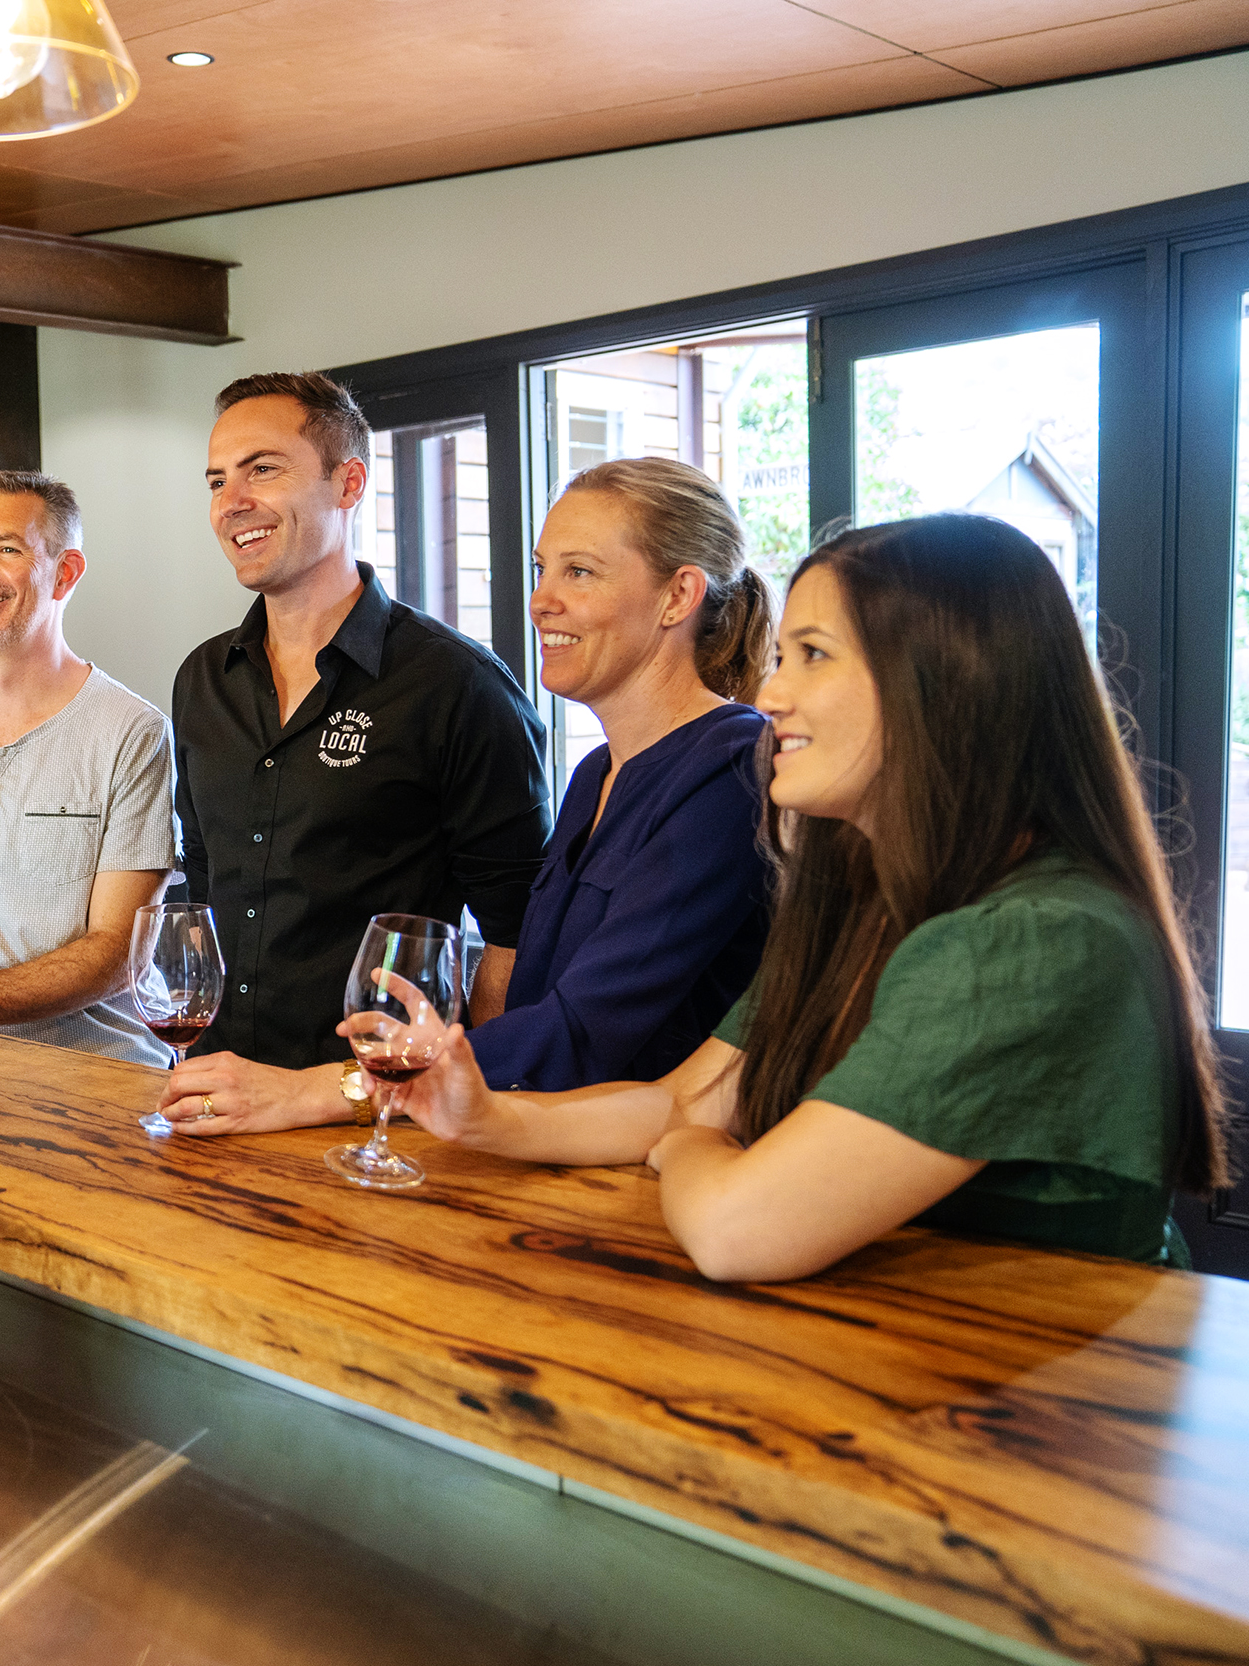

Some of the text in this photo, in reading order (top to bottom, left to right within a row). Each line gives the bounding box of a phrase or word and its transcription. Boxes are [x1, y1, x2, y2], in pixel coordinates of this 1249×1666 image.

[328, 709, 373, 730] UP CLOSE
[319, 730, 366, 754] LOCAL
